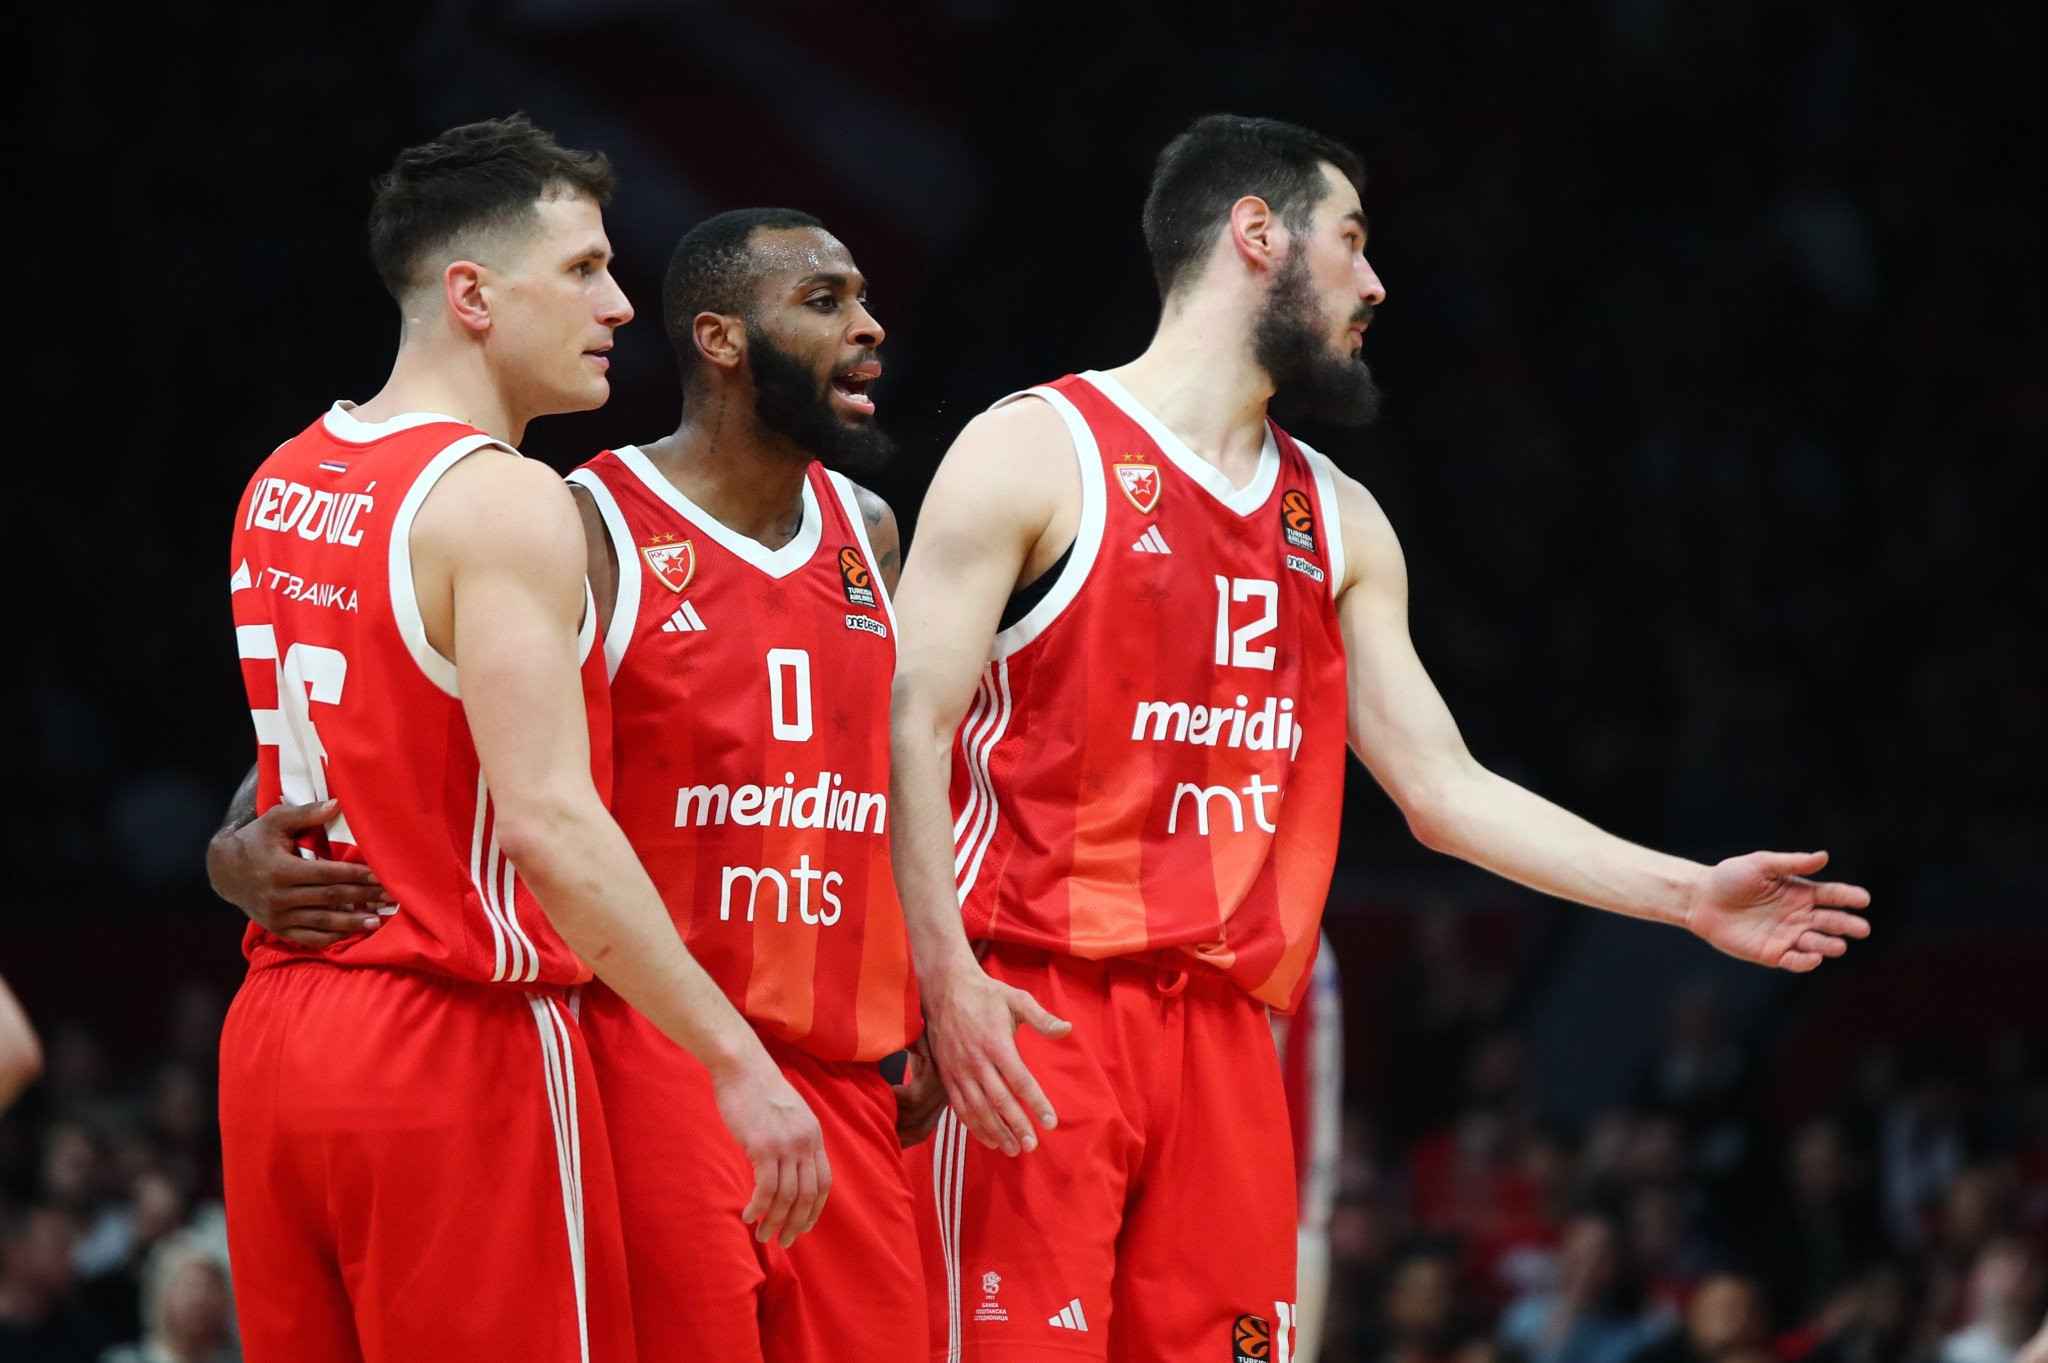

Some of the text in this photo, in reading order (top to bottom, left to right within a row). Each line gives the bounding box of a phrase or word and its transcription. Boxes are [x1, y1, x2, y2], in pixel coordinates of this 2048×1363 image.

[1214, 574, 1279, 671] 12
[766, 647, 814, 742] 0
[1131, 694, 1303, 762] meridi
[674, 771, 888, 835] meridian
[1167, 774, 1285, 836] mt
[719, 855, 844, 927] mts
